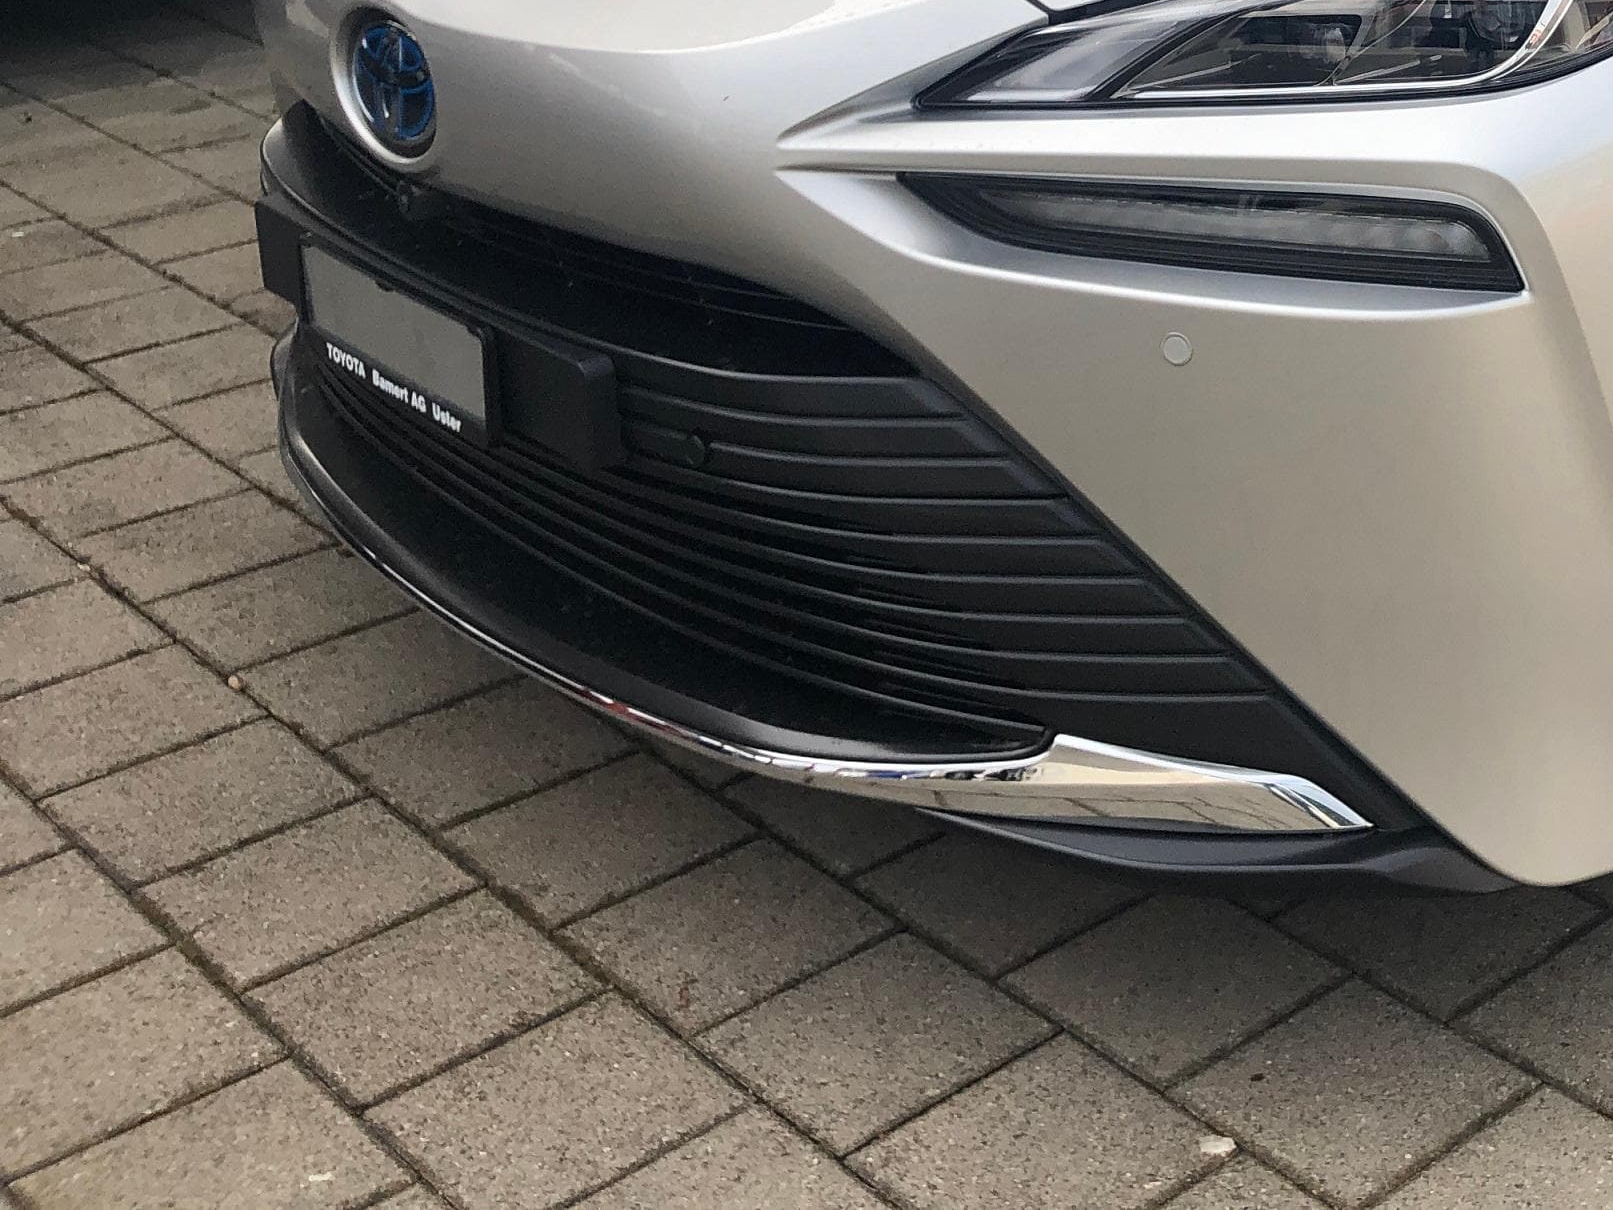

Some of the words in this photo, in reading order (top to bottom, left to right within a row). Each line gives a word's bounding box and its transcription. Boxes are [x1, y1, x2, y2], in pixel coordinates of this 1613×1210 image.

[326, 341, 366, 379] TOYOTA
[411, 391, 427, 413] AG
[432, 402, 461, 433] Uster
